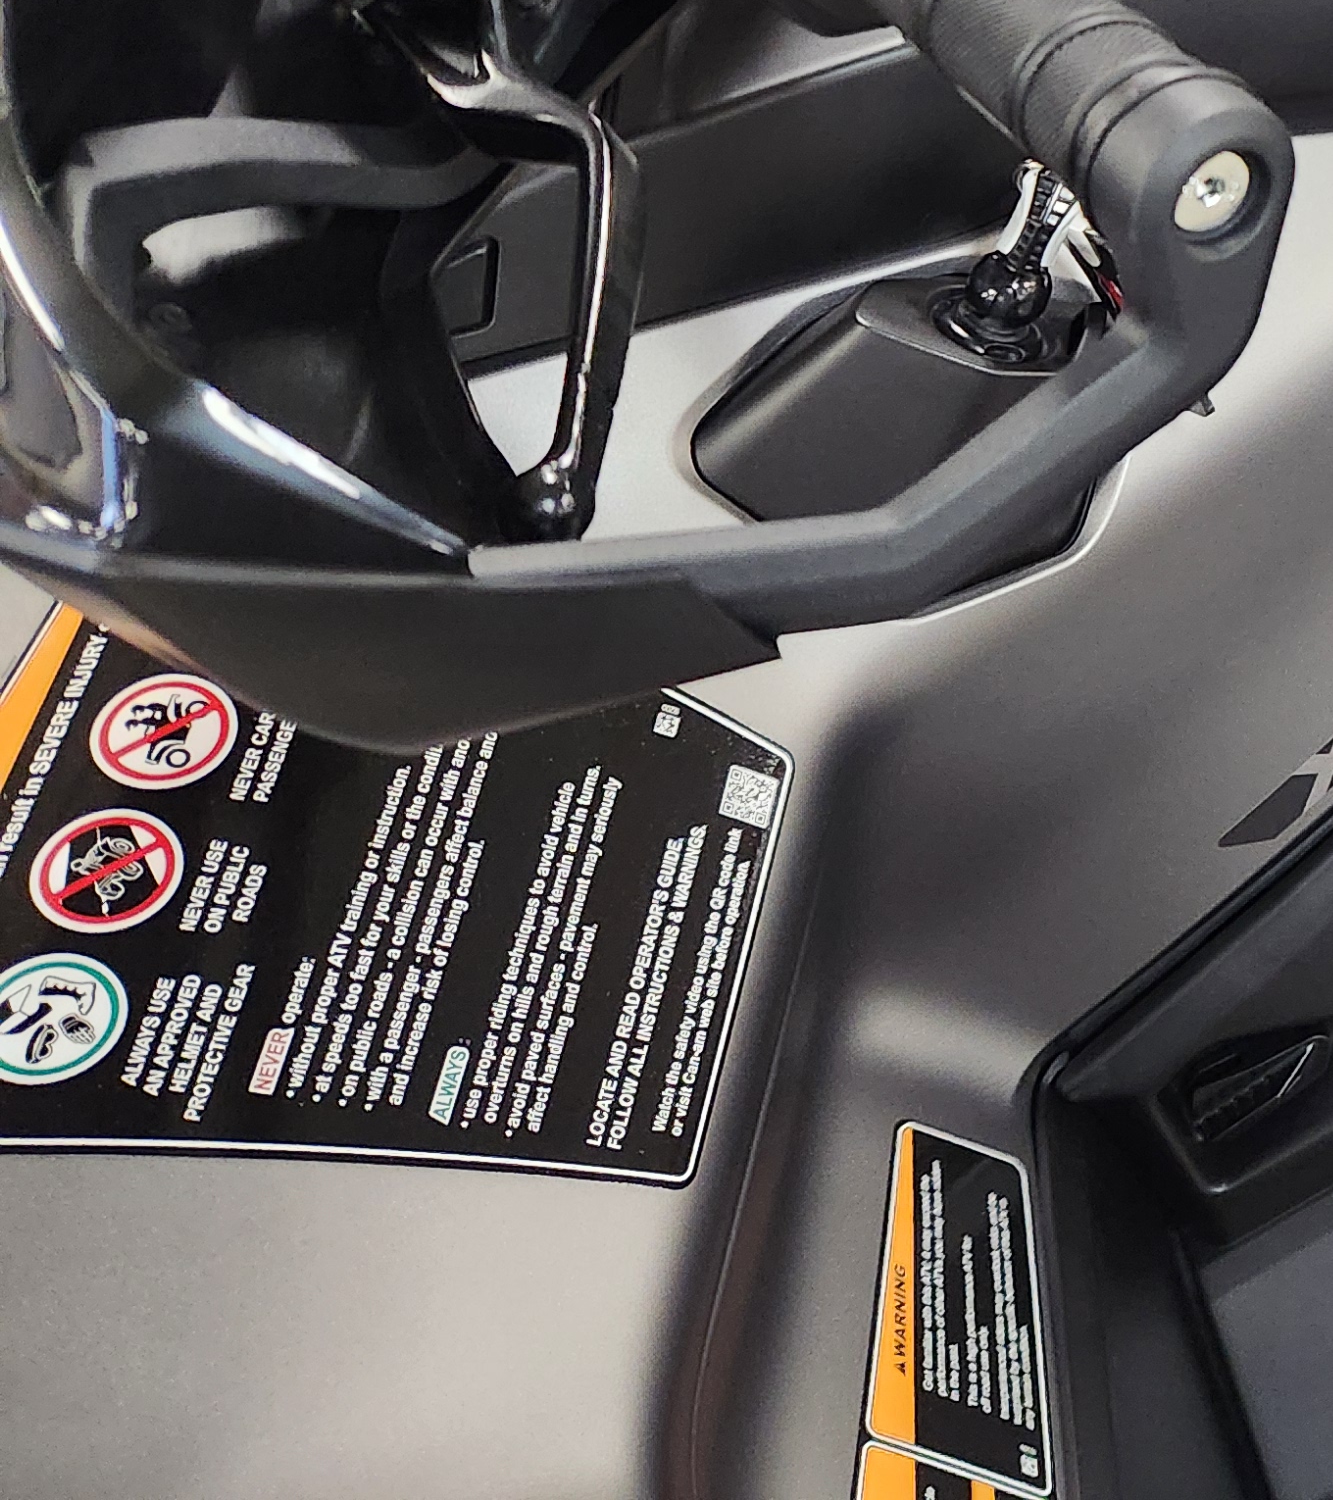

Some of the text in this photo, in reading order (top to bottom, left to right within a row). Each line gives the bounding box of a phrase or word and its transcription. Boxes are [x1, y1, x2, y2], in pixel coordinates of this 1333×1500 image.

[0, 636, 106, 851] result in SEVERE INJURY
[229, 712, 275, 800] NEVER CAR
[253, 719, 296, 801] PASSENGE
[456, 761, 487, 817] balance
[179, 839, 227, 930] NEVER USE
[203, 846, 248, 932] ON PUBLIC
[232, 865, 266, 921] ROADS
[444, 819, 469, 862] affect
[288, 765, 410, 1086] without proper ATV training or instruction.
[315, 744, 442, 1092] at speeds too fast for your skills or the condit
[341, 737, 471, 1096] on public roads a collision can occur with ano
[389, 840, 484, 1104] and increase risk of losing control.
[415, 865, 453, 954] passengers
[463, 782, 574, 1118] use proper riding techniques to avoid vehicle
[484, 766, 600, 1122] overturns on hills and rough terrain and in turns.
[507, 777, 621, 1127] avoid paved surfaces pavement may seriously
[121, 977, 175, 1085] ALWAYS USE
[143, 974, 200, 1095] AN APPROVED
[169, 984, 221, 1092] HELMET AND
[183, 964, 254, 1120] PROTECTIVE GEAR
[254, 957, 315, 1090] NEVER operate:
[384, 965, 420, 1049] passenger
[526, 923, 597, 1131] affect handling and control.
[586, 838, 683, 1145] LOCATE AND READ OPERATOR'S GUIDE.
[607, 825, 706, 1149] FOLLOW ALL INSTRUCTIONS & WARNINGS.
[652, 828, 742, 1130] Watch the safety video using the QR code link
[671, 861, 750, 1136] or visit Can-am web site before operation.
[366, 1066, 388, 1100] with
[379, 1052, 393, 1063] a
[893, 1263, 907, 1357] WARNING
